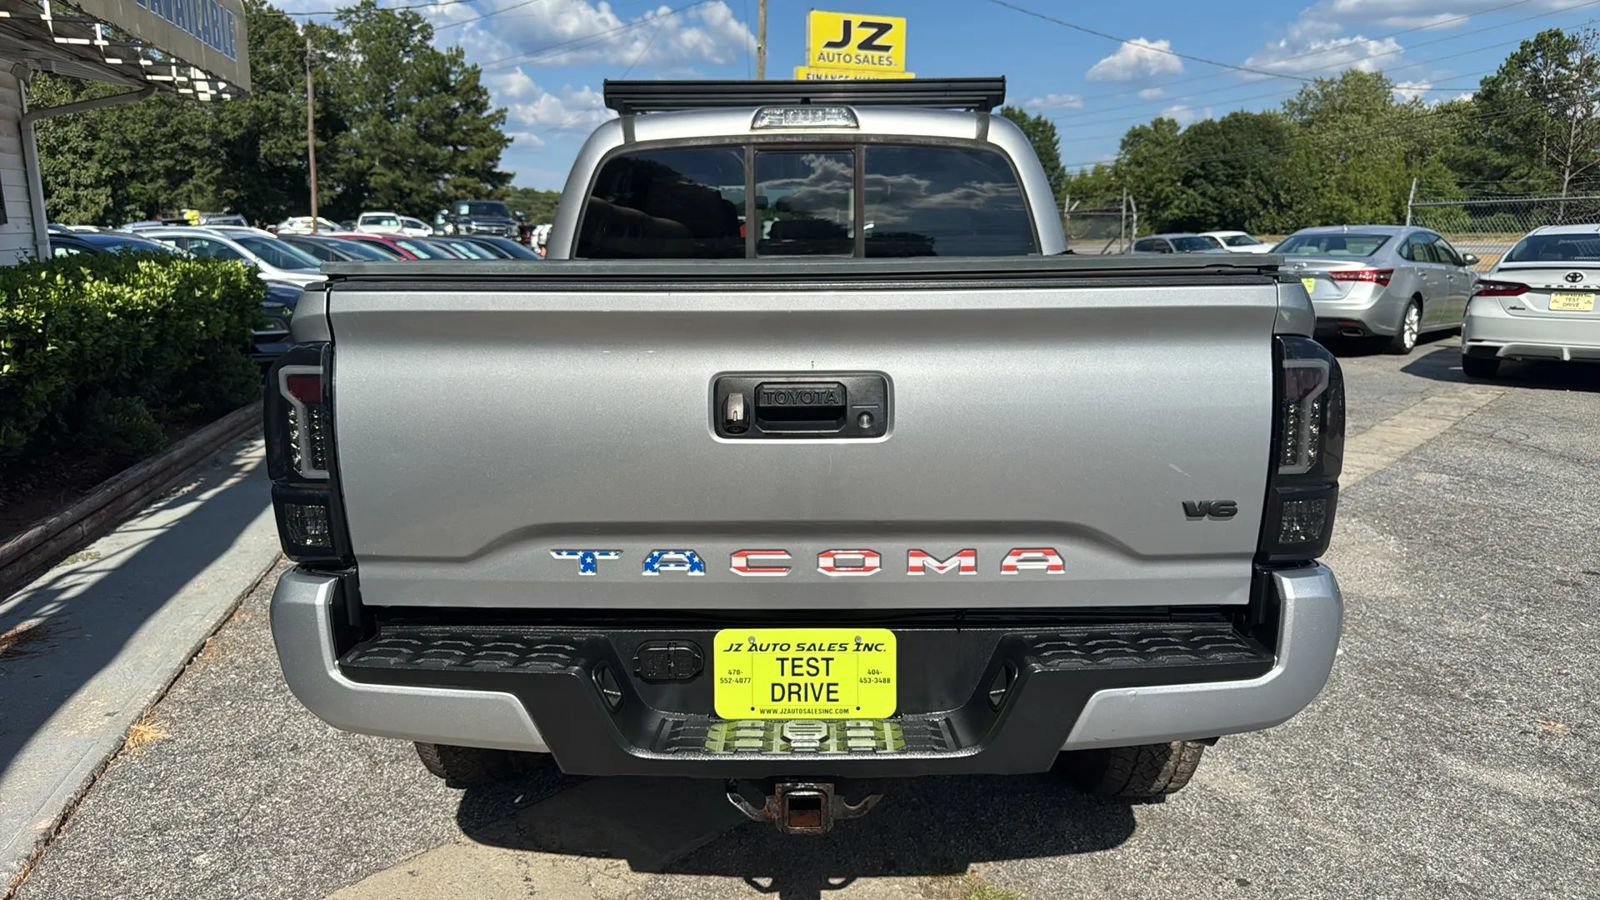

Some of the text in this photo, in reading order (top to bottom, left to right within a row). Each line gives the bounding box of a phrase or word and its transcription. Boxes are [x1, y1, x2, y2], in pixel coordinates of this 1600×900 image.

[822, 19, 894, 53] JZ
[817, 51, 853, 64] AUTO
[763, 390, 839, 405] TOYOTA
[1182, 499, 1238, 521] V6
[549, 548, 1066, 578] TACOMA
[722, 642, 887, 653] JZ AUTO SALES INC.
[775, 656, 835, 678] TEST
[867, 668, 883, 676] 404-
[770, 682, 840, 703] DRIVE
[759, 707, 850, 715] WWW.JZAUTOSALESINC.COM
